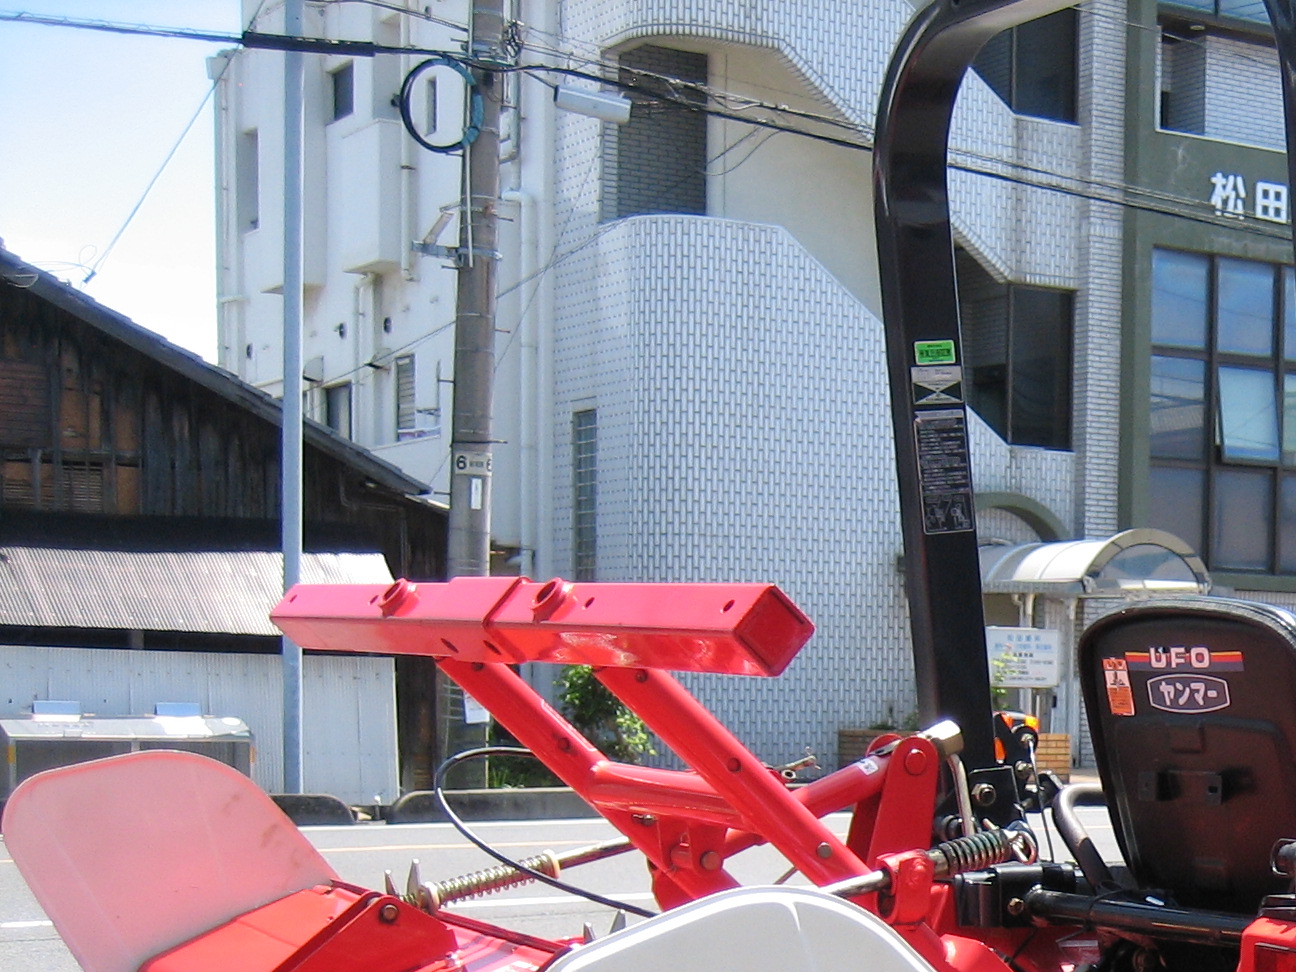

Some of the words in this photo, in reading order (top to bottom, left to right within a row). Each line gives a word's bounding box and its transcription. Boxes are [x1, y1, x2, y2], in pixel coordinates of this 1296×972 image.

[1210, 172, 1288, 224] 松田
[456, 455, 467, 470] 6
[1149, 646, 1211, 669] UFO
[1159, 681, 1218, 706] ヤンマー
